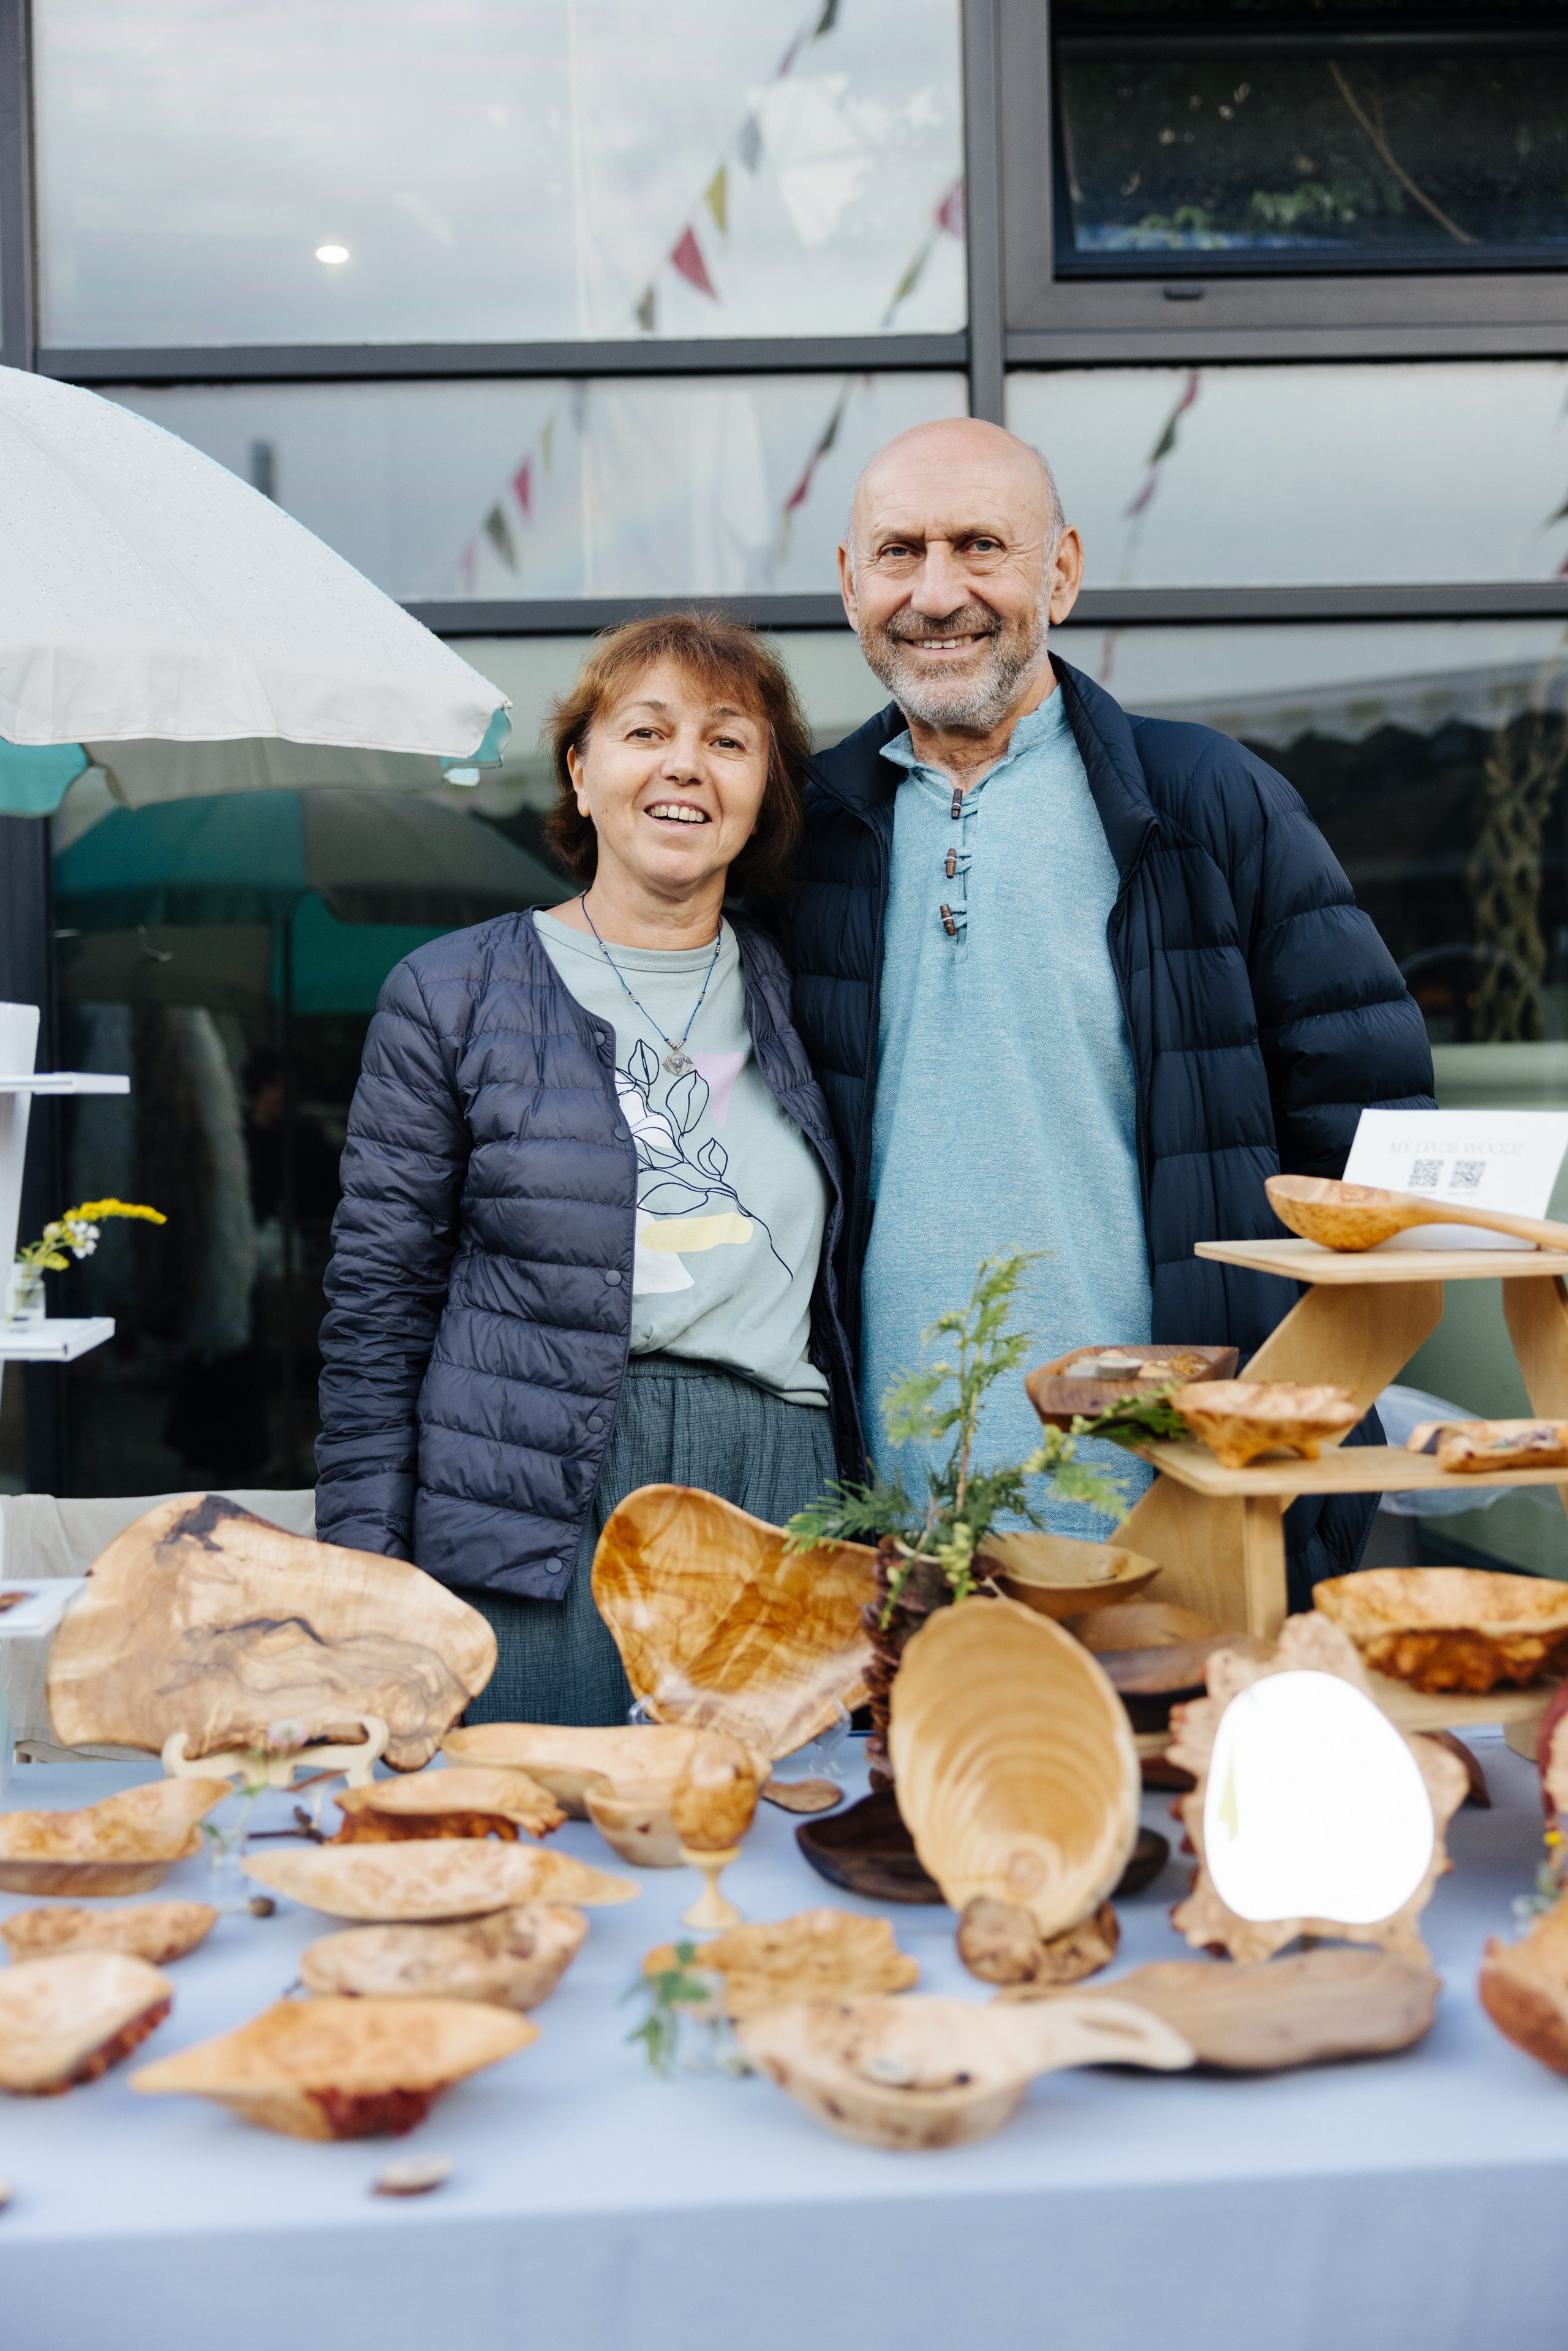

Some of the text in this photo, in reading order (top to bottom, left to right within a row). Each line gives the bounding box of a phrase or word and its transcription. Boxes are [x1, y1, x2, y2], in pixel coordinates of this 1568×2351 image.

[1389, 1141, 1525, 1156] MY DADS WOODZ
